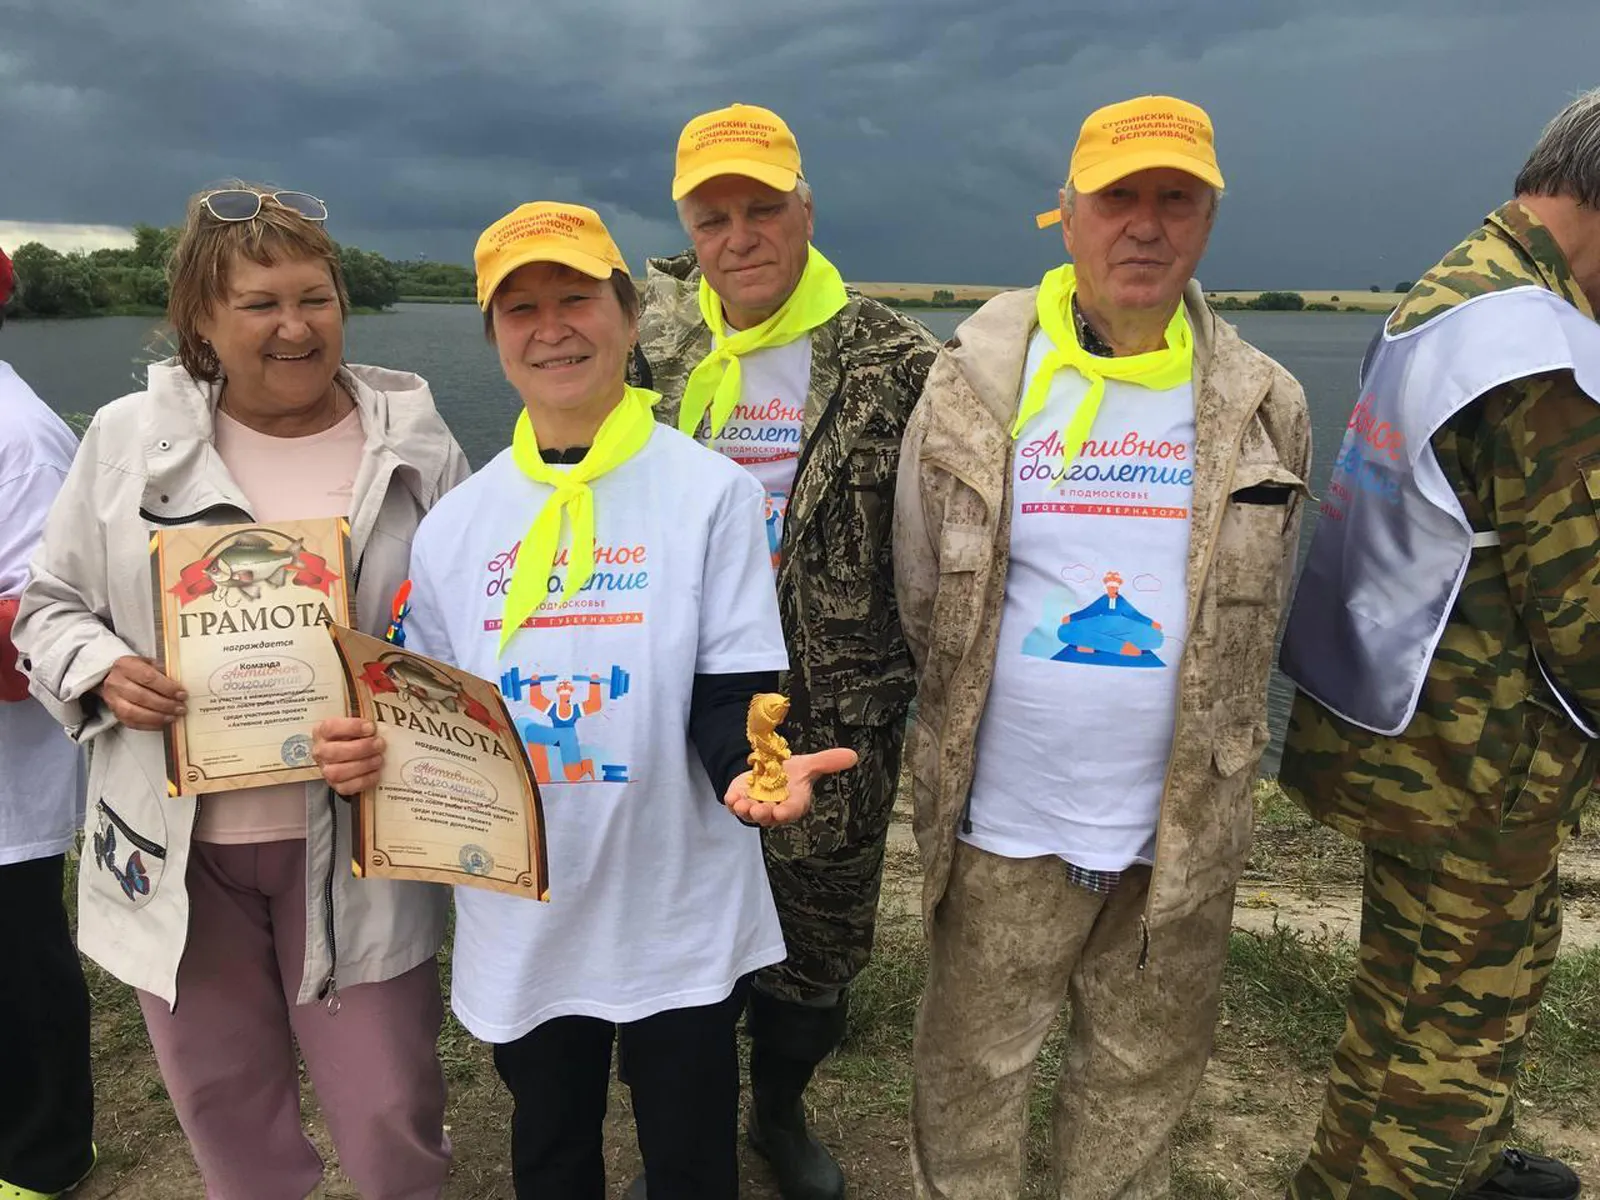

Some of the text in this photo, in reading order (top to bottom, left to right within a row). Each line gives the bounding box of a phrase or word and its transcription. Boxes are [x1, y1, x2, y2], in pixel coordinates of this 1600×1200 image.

[698, 128, 767, 141] СОЦИАЛЬНОГО
[1115, 121, 1195, 134] СОЦИАЛЬНОГО
[1111, 130, 1197, 145] ОБСЛУЖИВАНИЯ
[1069, 489, 1149, 500] ПОДМОСКОВЬЕ
[1025, 503, 1186, 518] ПРОЕКТ ГУБЕРНАТОРА
[180, 602, 334, 638] ГРАМОТА
[550, 615, 640, 625] ГУБЕРНАТОРА
[223, 639, 294, 653] награждается
[239, 661, 281, 670] Команда
[372, 700, 513, 762] ГРАМОТА
[415, 741, 477, 763] награждается
